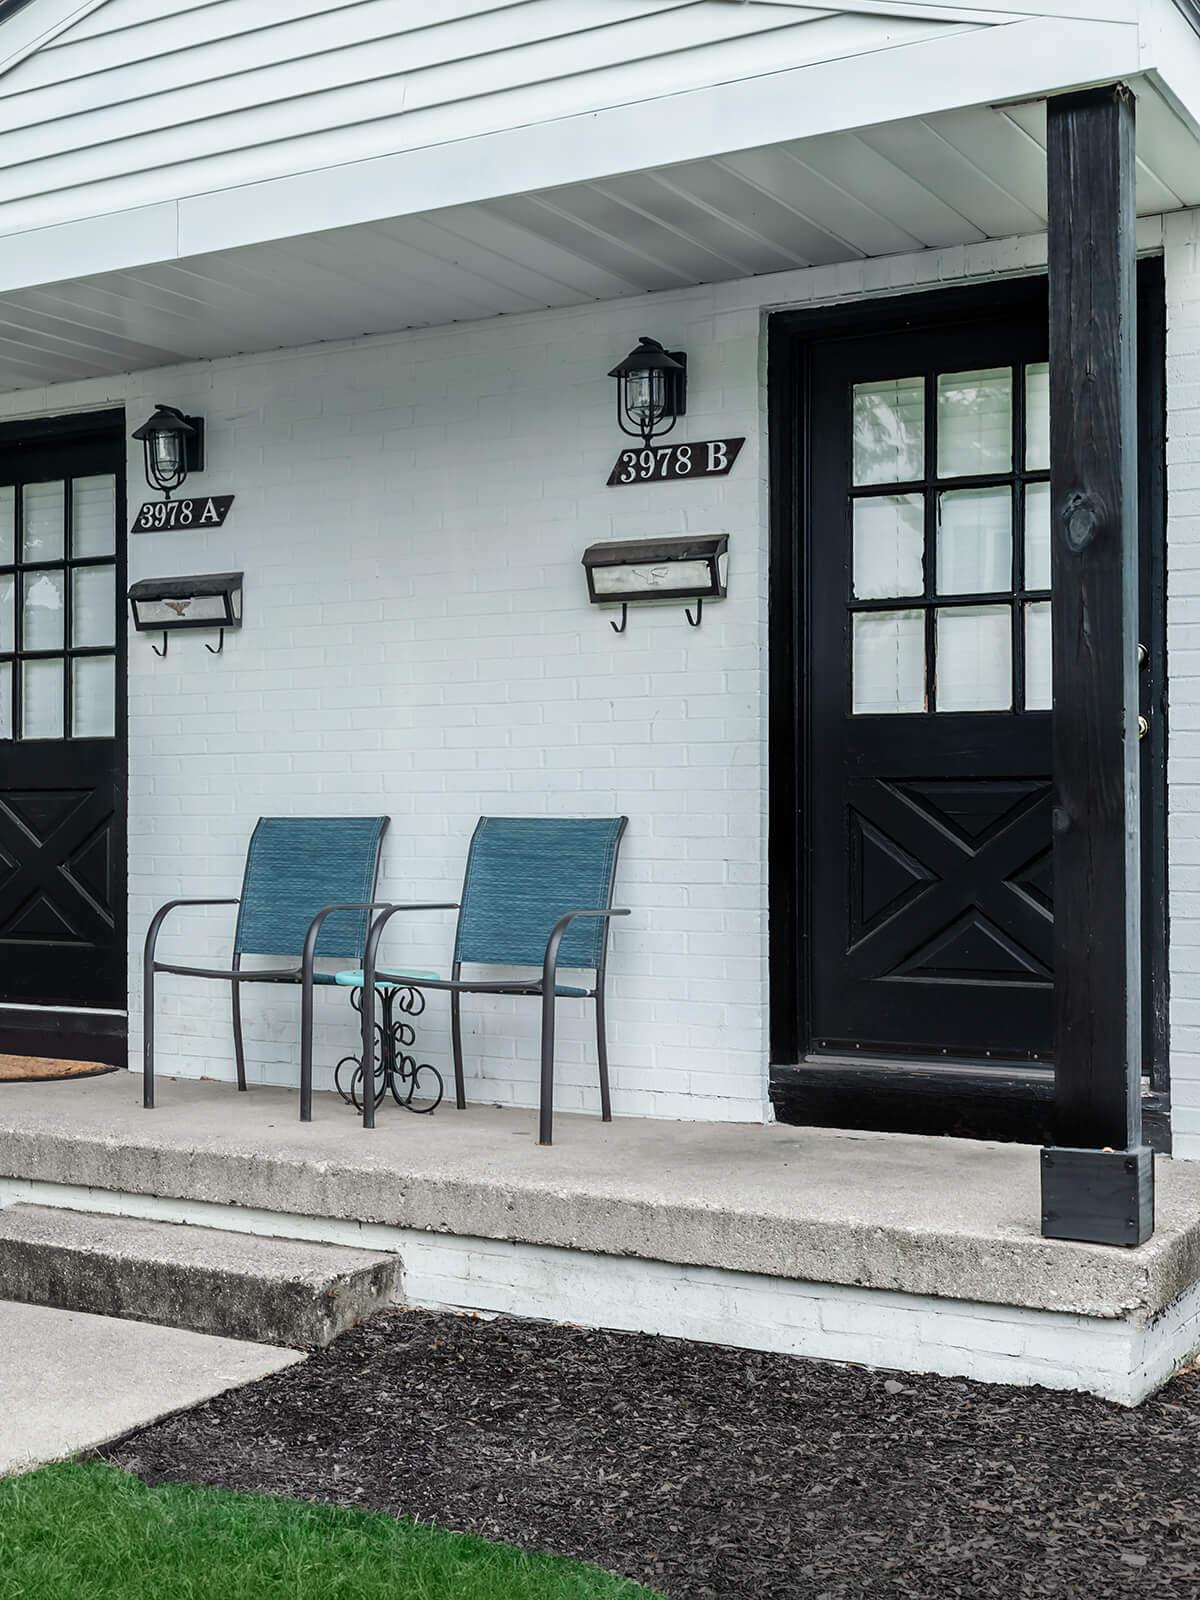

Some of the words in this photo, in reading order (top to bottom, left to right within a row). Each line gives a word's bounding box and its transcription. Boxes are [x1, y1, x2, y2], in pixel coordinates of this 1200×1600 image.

[620, 446, 692, 483] 3978
[706, 442, 727, 472] B
[140, 500, 193, 528] 3978
[200, 498, 220, 523] A
